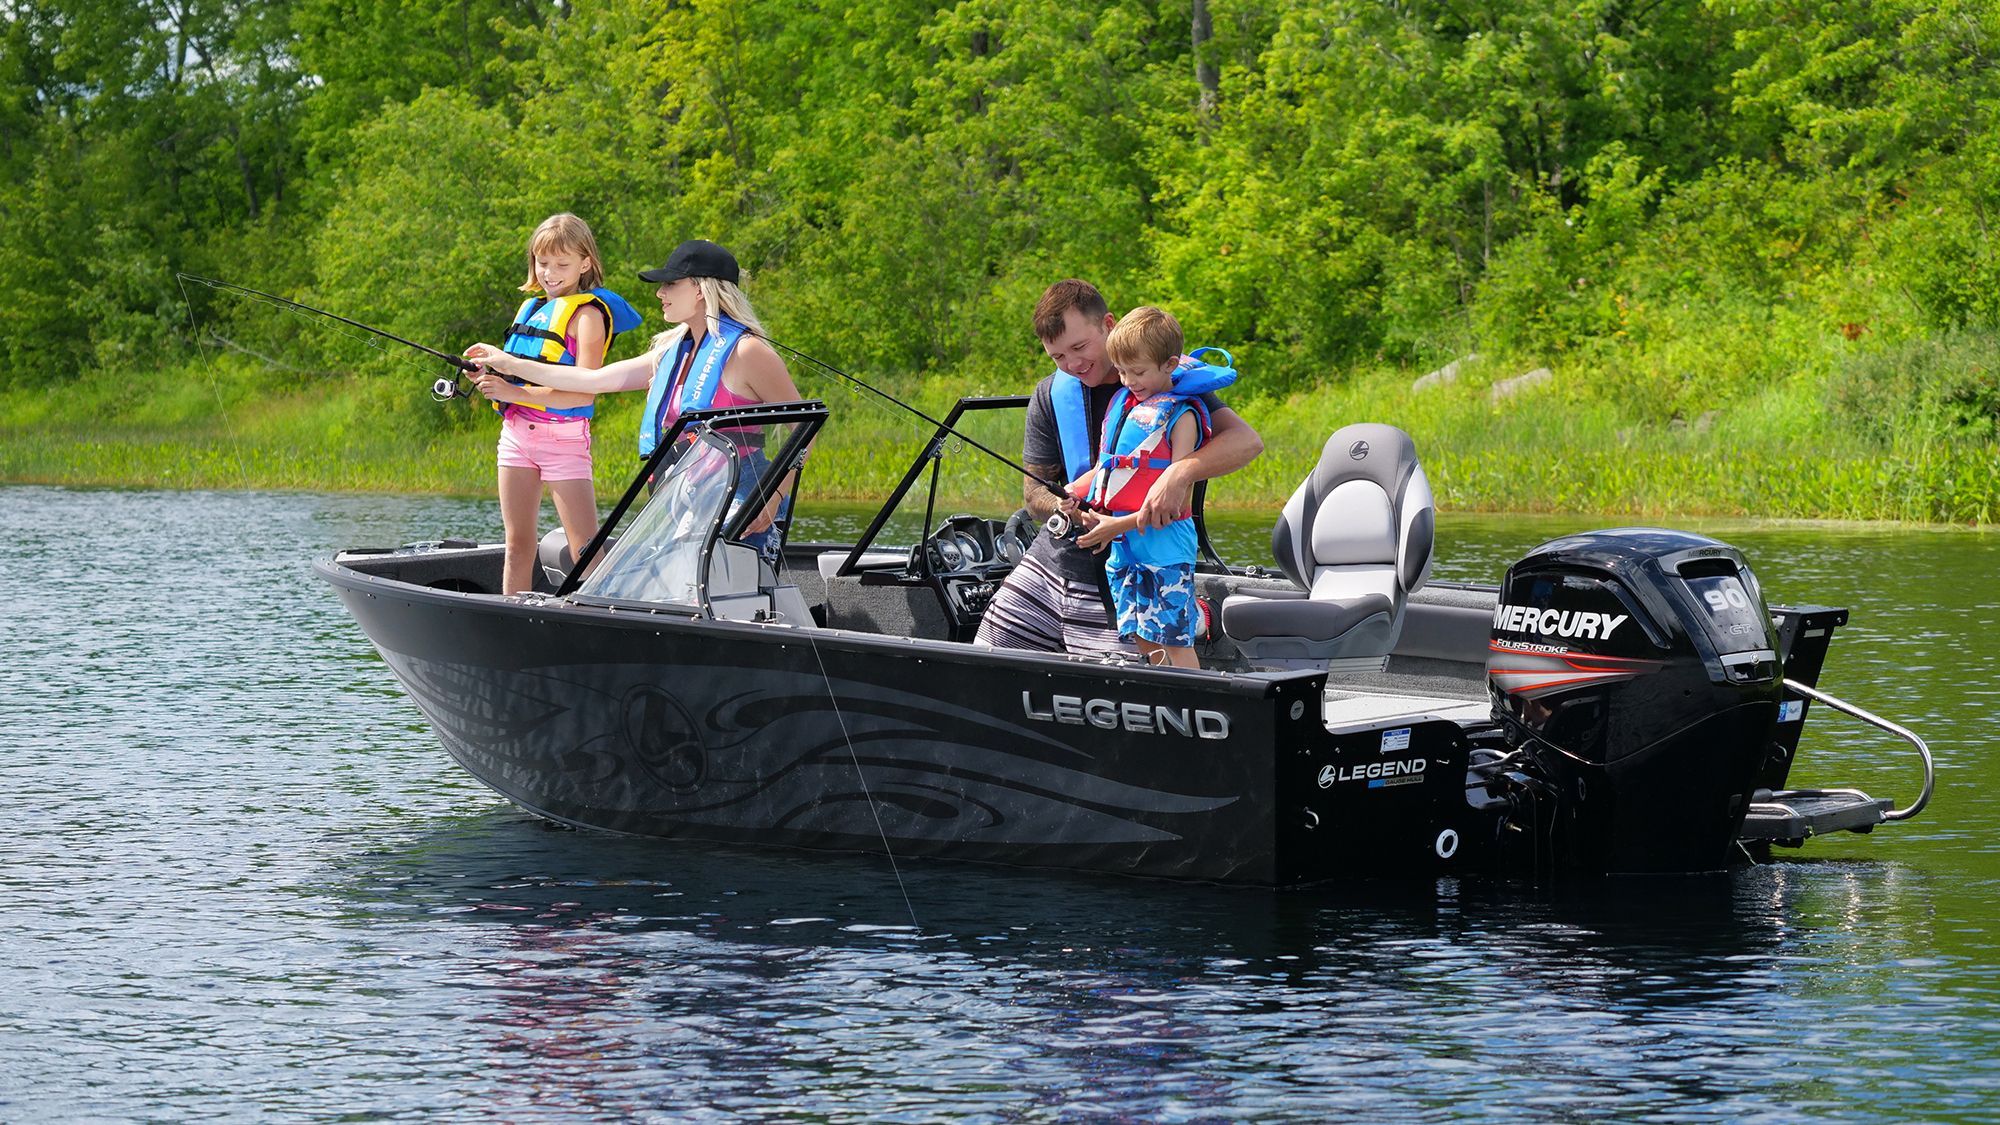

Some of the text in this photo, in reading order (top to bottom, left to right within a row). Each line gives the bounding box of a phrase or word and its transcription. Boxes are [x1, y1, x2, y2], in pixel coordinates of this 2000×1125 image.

[692, 348, 720, 401] LEGEND
[1687, 548, 1721, 558] MERCURY
[1703, 588, 1747, 612] 90
[1493, 603, 1629, 640] MERCURY
[1022, 690, 1230, 740] LEGEND
[1338, 758, 1427, 782] LEGEND
